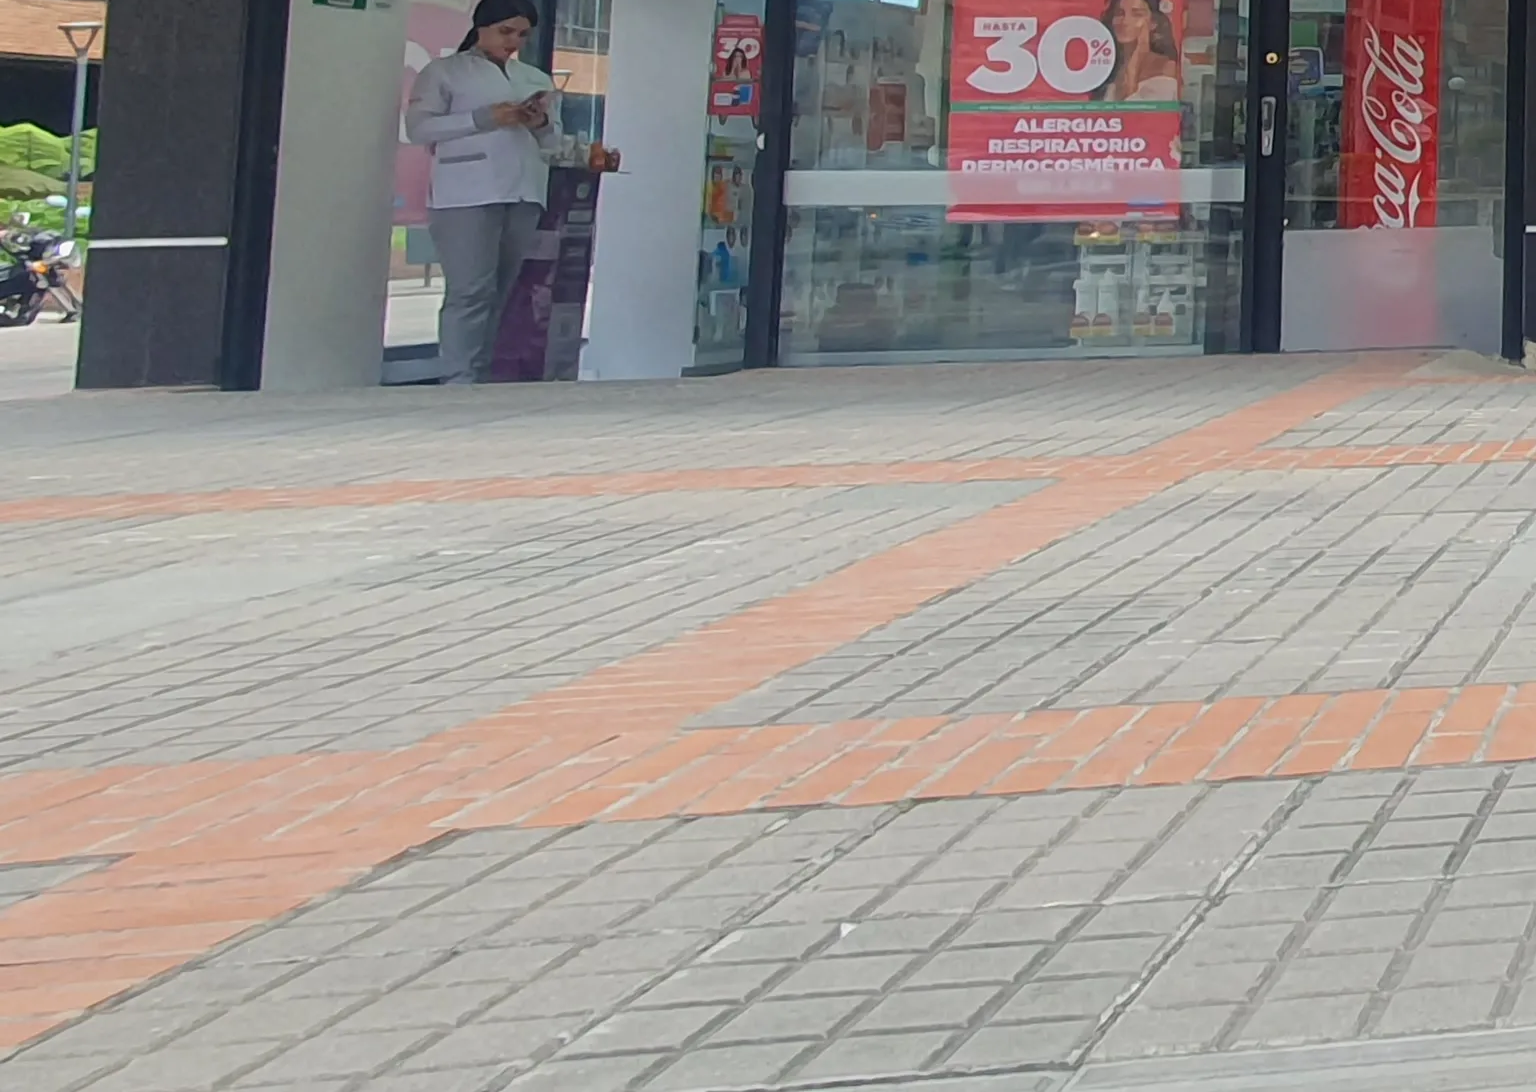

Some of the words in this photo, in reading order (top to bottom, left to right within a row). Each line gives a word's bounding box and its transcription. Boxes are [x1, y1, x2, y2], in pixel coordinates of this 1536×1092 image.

[982, 22, 1027, 31] HASTA
[965, 15, 1116, 94] 30
[1013, 118, 1122, 133] ALERGIAS
[988, 138, 1146, 154] RESPIRATORIO
[961, 155, 1165, 173] DERMOCOSMÉTICA
